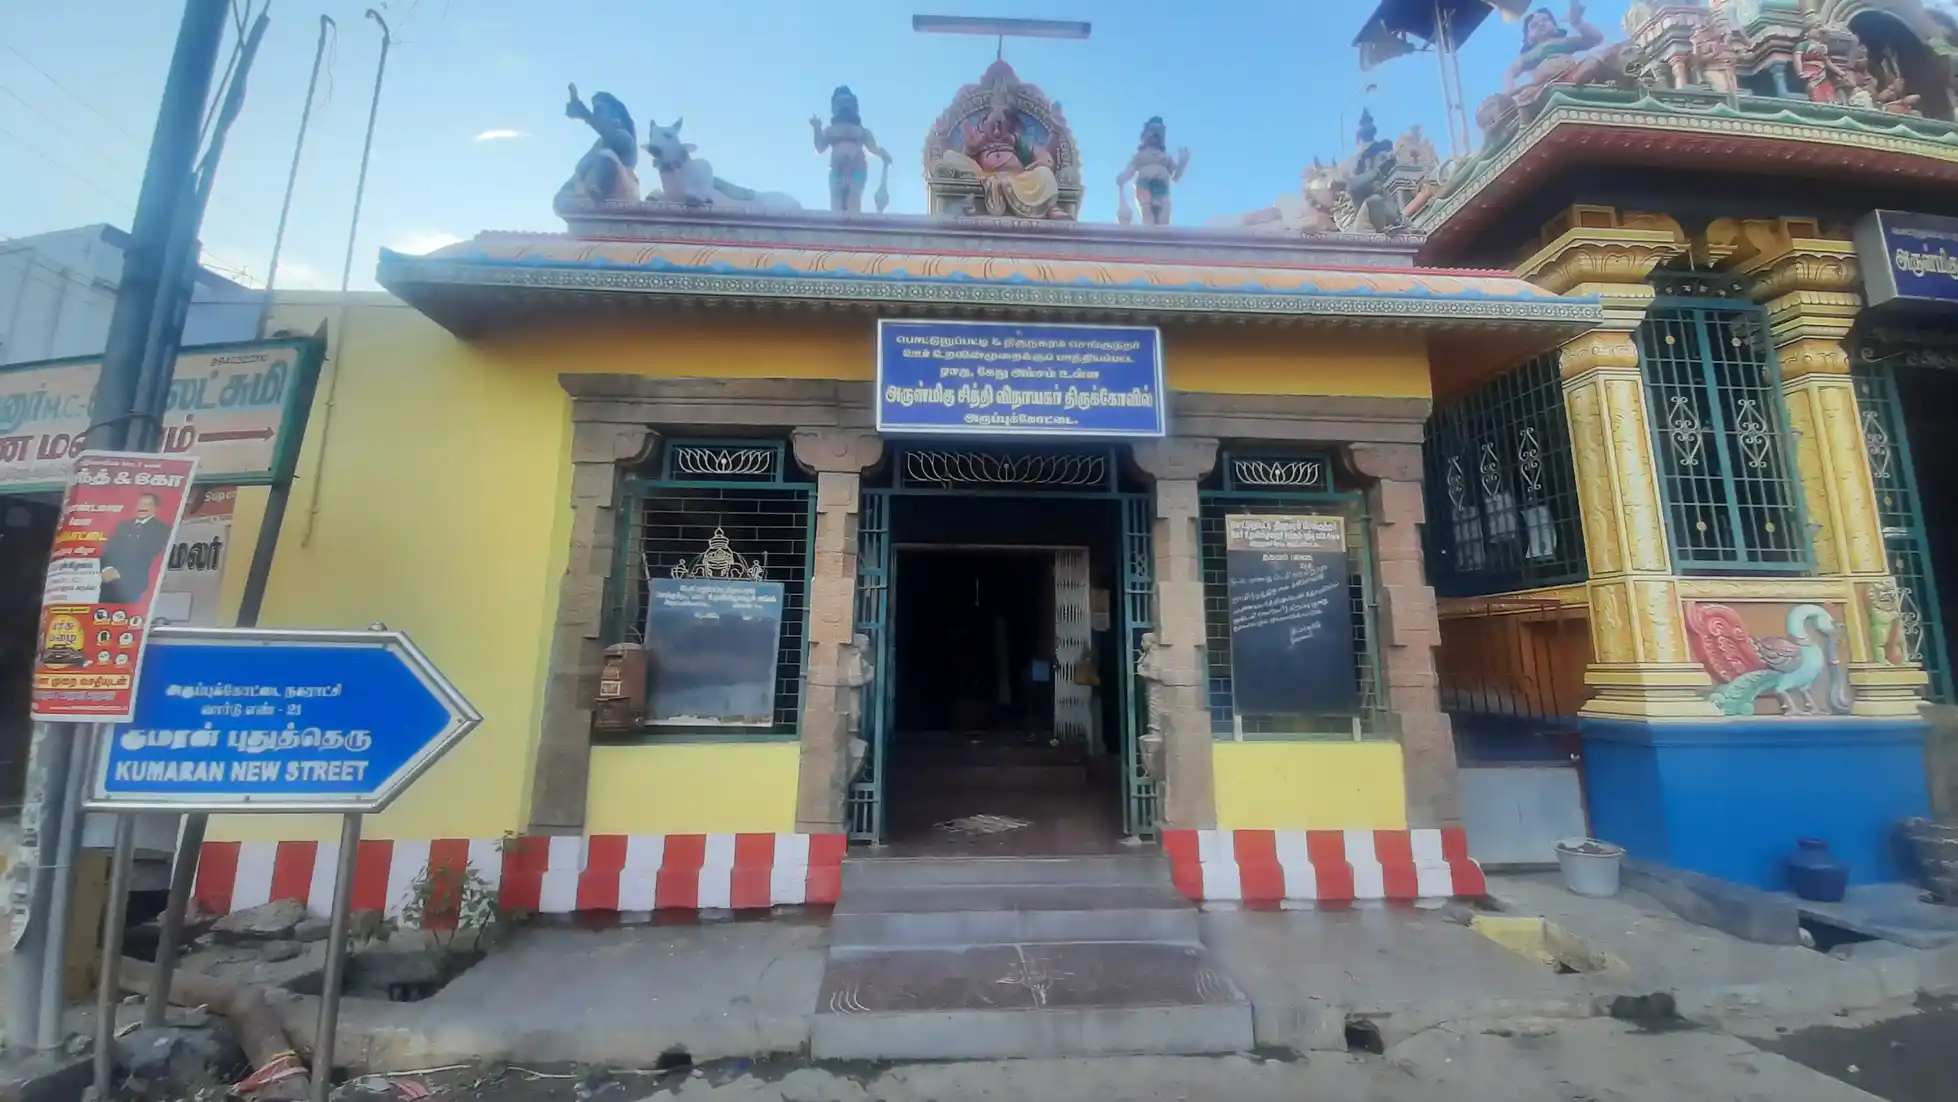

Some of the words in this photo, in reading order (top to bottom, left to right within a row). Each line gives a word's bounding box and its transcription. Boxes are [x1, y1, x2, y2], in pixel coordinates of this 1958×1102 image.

[886, 380, 955, 407] அருள்மிகு
[958, 381, 994, 409] சித்தி
[996, 383, 1062, 410] விநாயகர்
[1064, 384, 1153, 410] திருக்கோவில்
[166, 682, 281, 699] அருப்புக்கோட்டை
[285, 683, 342, 700] நகராட்சி
[201, 701, 242, 717] வார்டு
[245, 701, 275, 716] எண்
[286, 704, 302, 716] 21
[120, 723, 221, 752] குமரன்
[227, 722, 372, 754] புதுத்தெரு
[115, 761, 225, 783] KUMARAN
[230, 761, 281, 783] NEW
[285, 760, 369, 783] STREET
